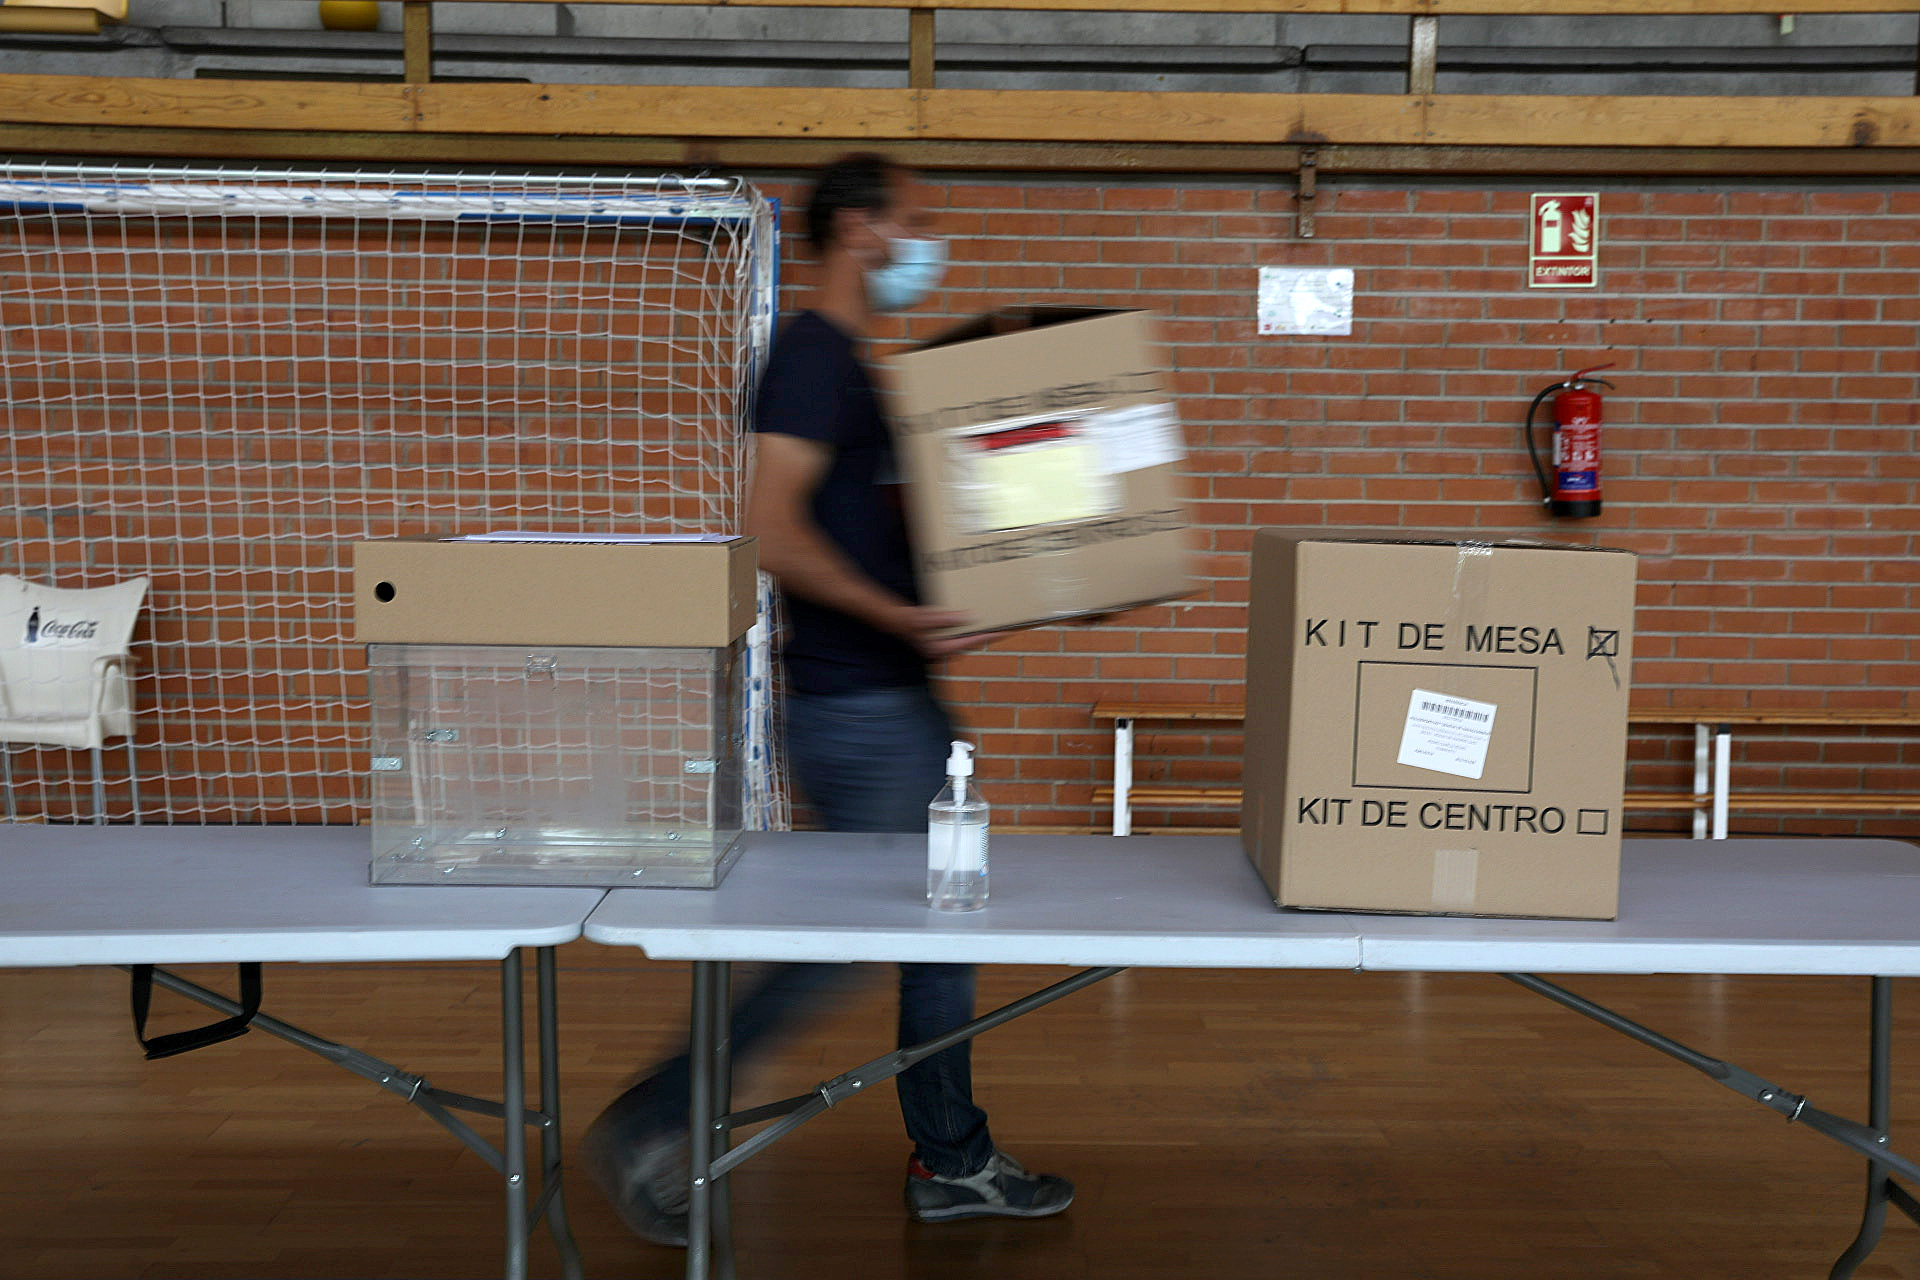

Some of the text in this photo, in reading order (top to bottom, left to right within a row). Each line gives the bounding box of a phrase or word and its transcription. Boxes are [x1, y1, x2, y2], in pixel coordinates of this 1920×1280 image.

[1536, 265, 1591, 276] EXTINTOR
[1304, 619, 1565, 655] KIT DE MESA
[1297, 797, 1566, 835] KIT DE CENTRO
